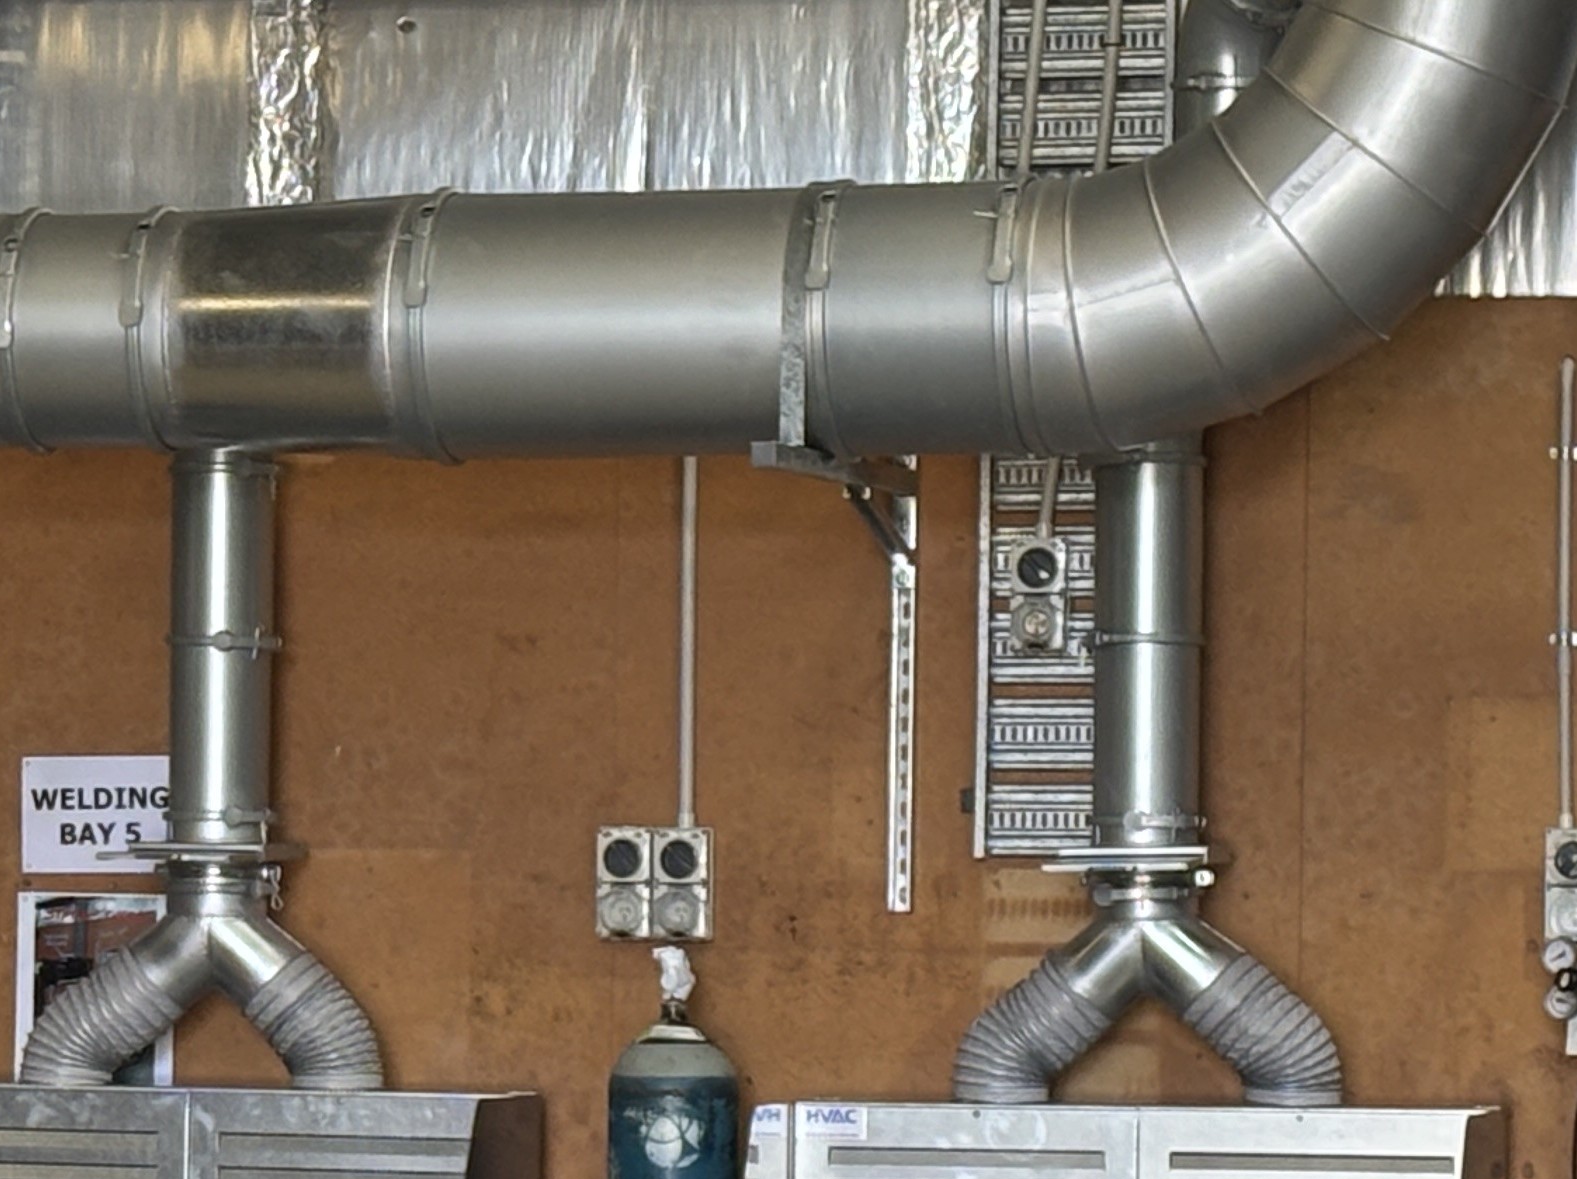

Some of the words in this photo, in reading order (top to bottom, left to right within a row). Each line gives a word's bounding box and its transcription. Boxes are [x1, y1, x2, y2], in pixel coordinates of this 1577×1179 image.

[30, 786, 170, 811] WELDING
[60, 822, 116, 845] BAY
[125, 821, 142, 844] 5
[806, 1108, 858, 1124] HVAC
